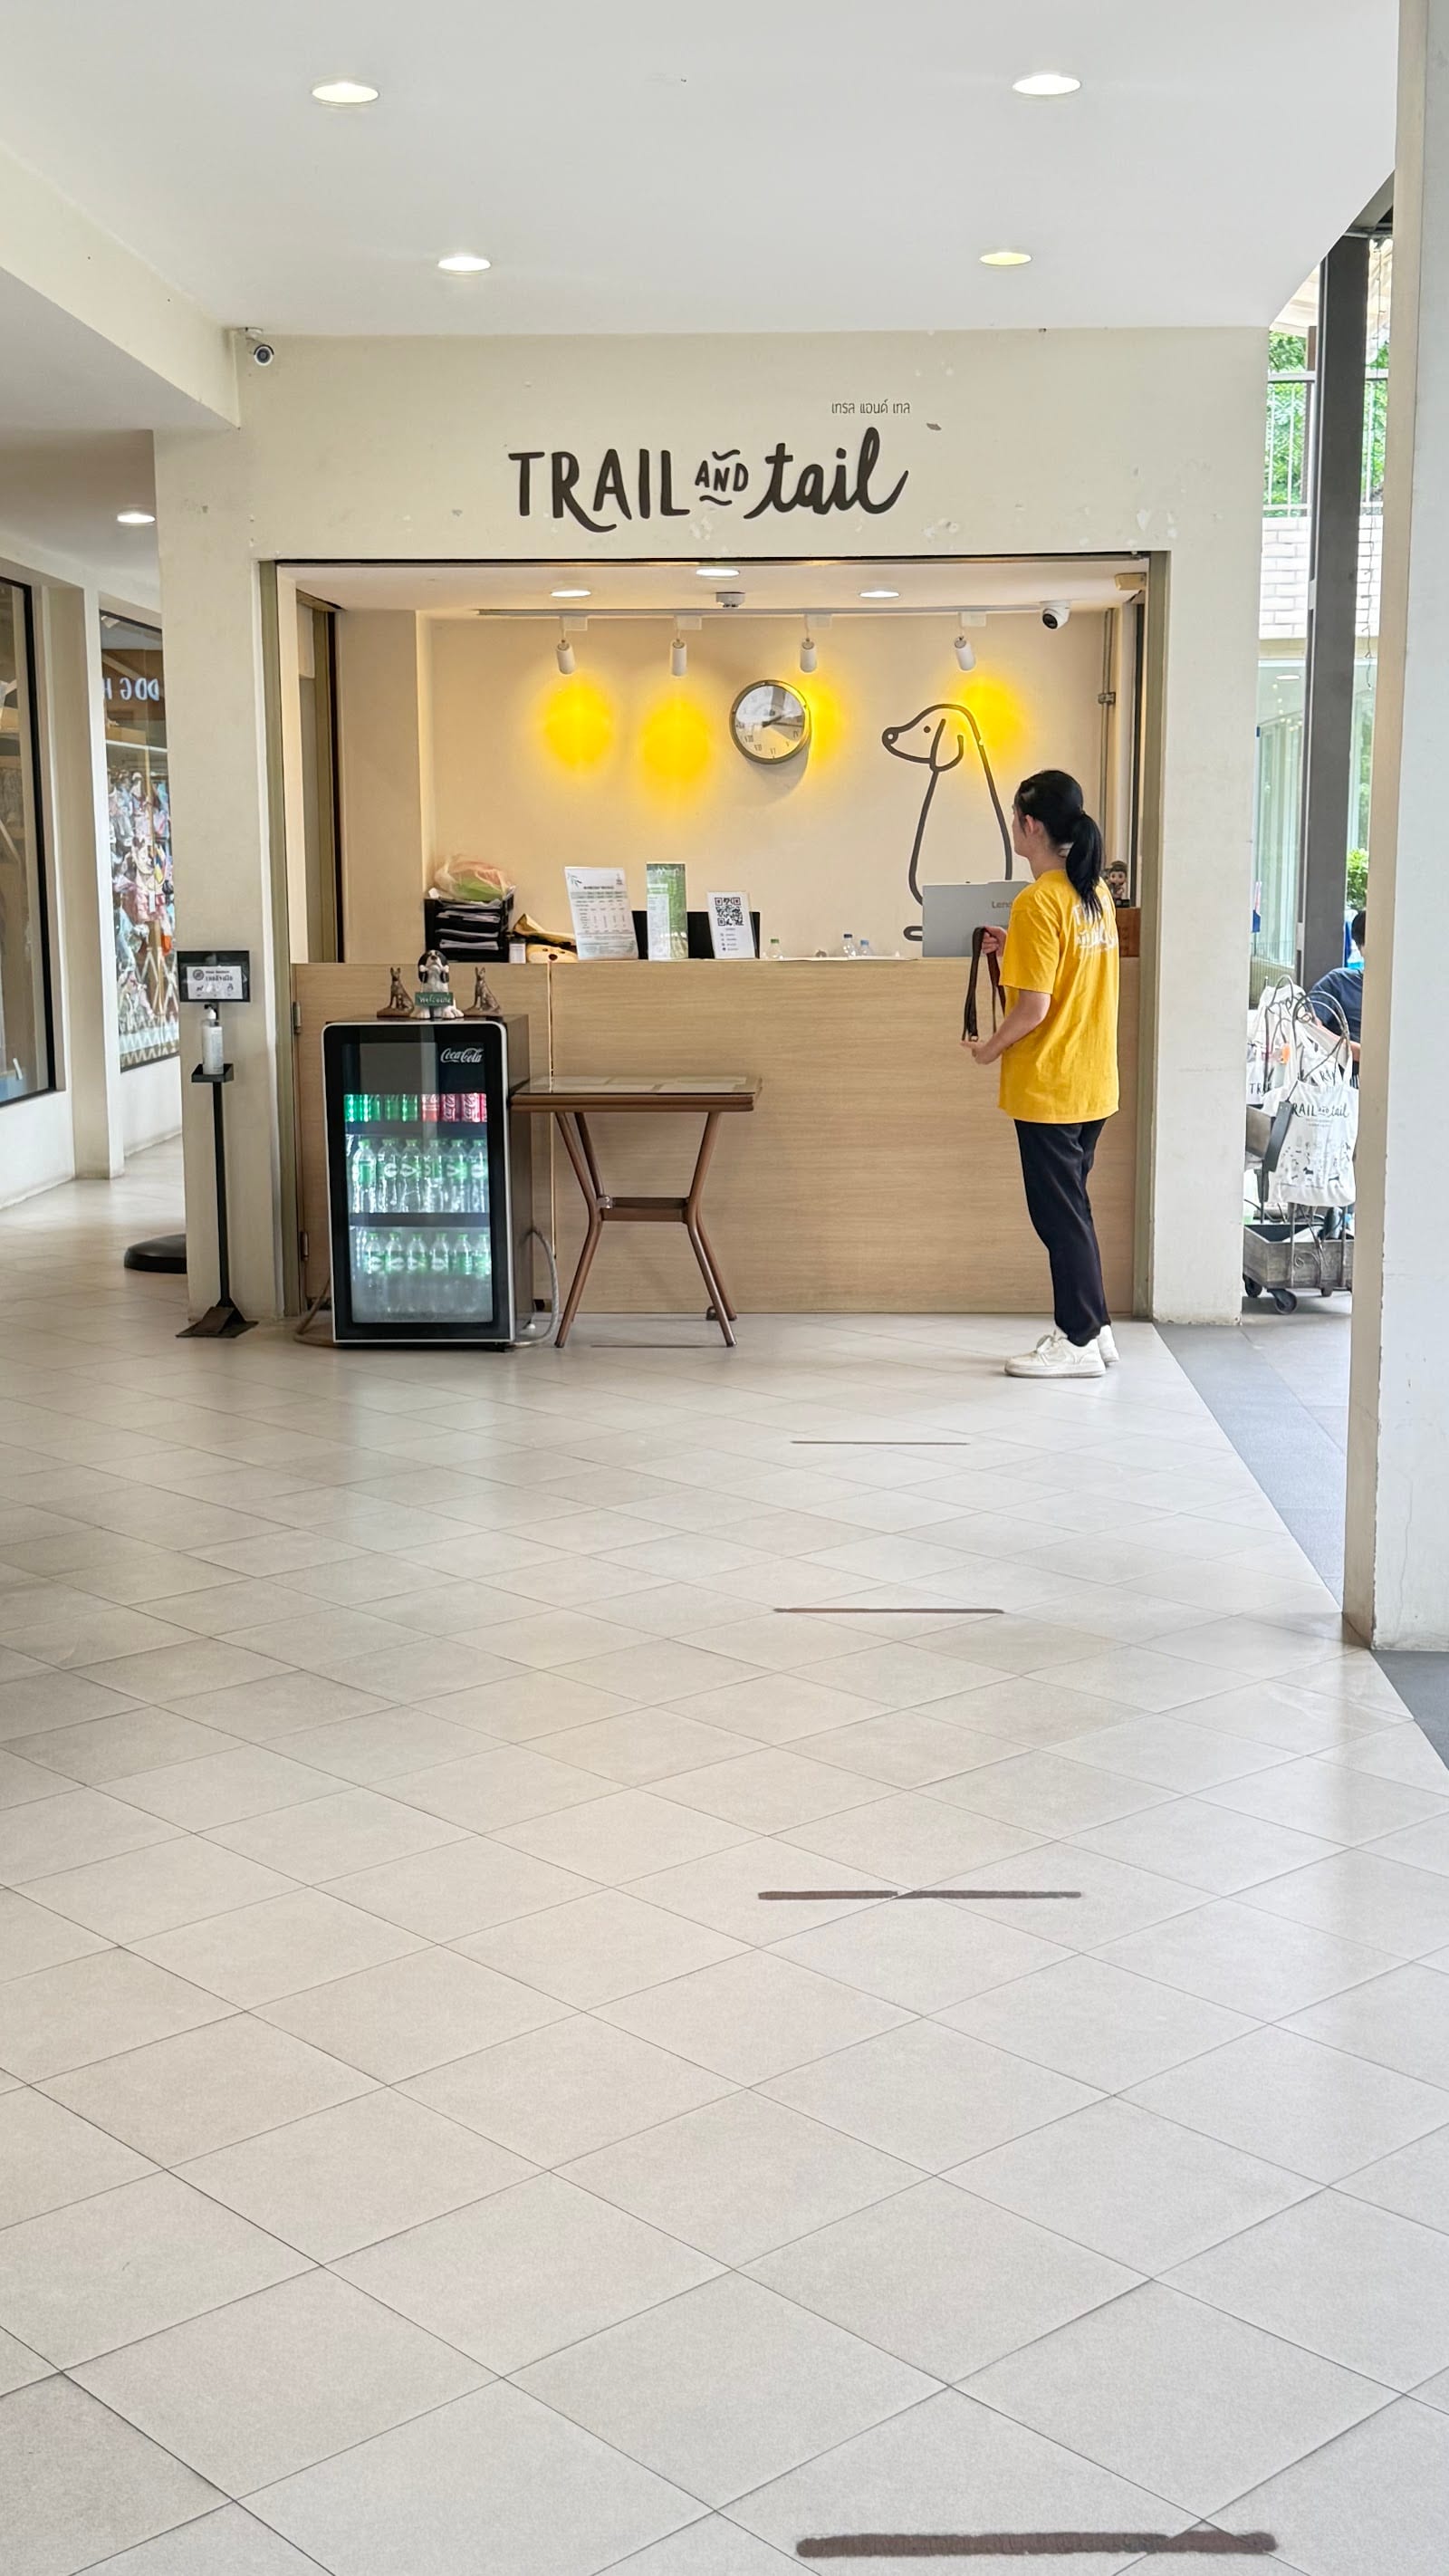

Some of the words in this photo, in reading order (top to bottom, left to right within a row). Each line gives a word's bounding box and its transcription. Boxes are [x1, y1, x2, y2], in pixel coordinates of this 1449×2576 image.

[831, 402, 855, 414] เทรล
[859, 399, 888, 414] แอนด์
[892, 402, 910, 414] เทล
[508, 447, 690, 533] TRAIL
[695, 460, 749, 493] AND
[743, 427, 909, 520] tail
[440, 1047, 485, 1063] Coca-Cola
[1291, 1102, 1318, 1118] RAIL
